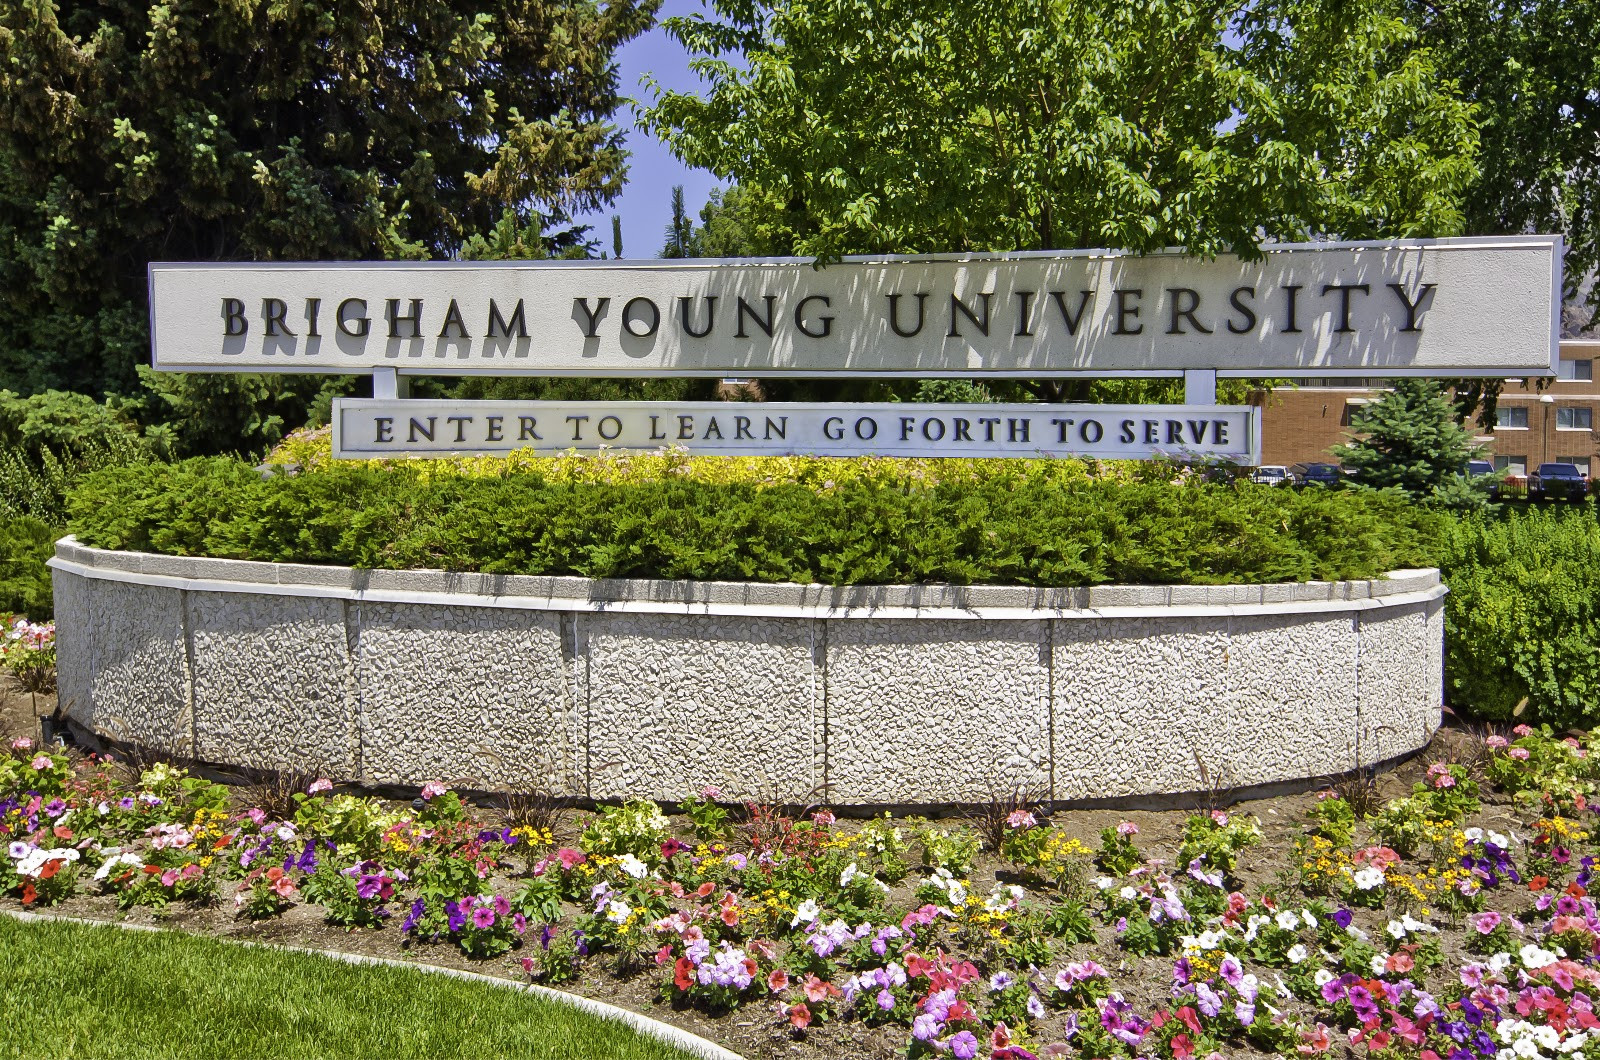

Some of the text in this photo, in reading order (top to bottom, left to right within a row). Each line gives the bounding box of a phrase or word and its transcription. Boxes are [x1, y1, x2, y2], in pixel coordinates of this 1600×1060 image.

[221, 283, 1438, 340] BRIGHAM YOUNG UNIVERSITY
[374, 415, 1230, 446] ENTER TO LEARN GO FORTH TO SERVE
